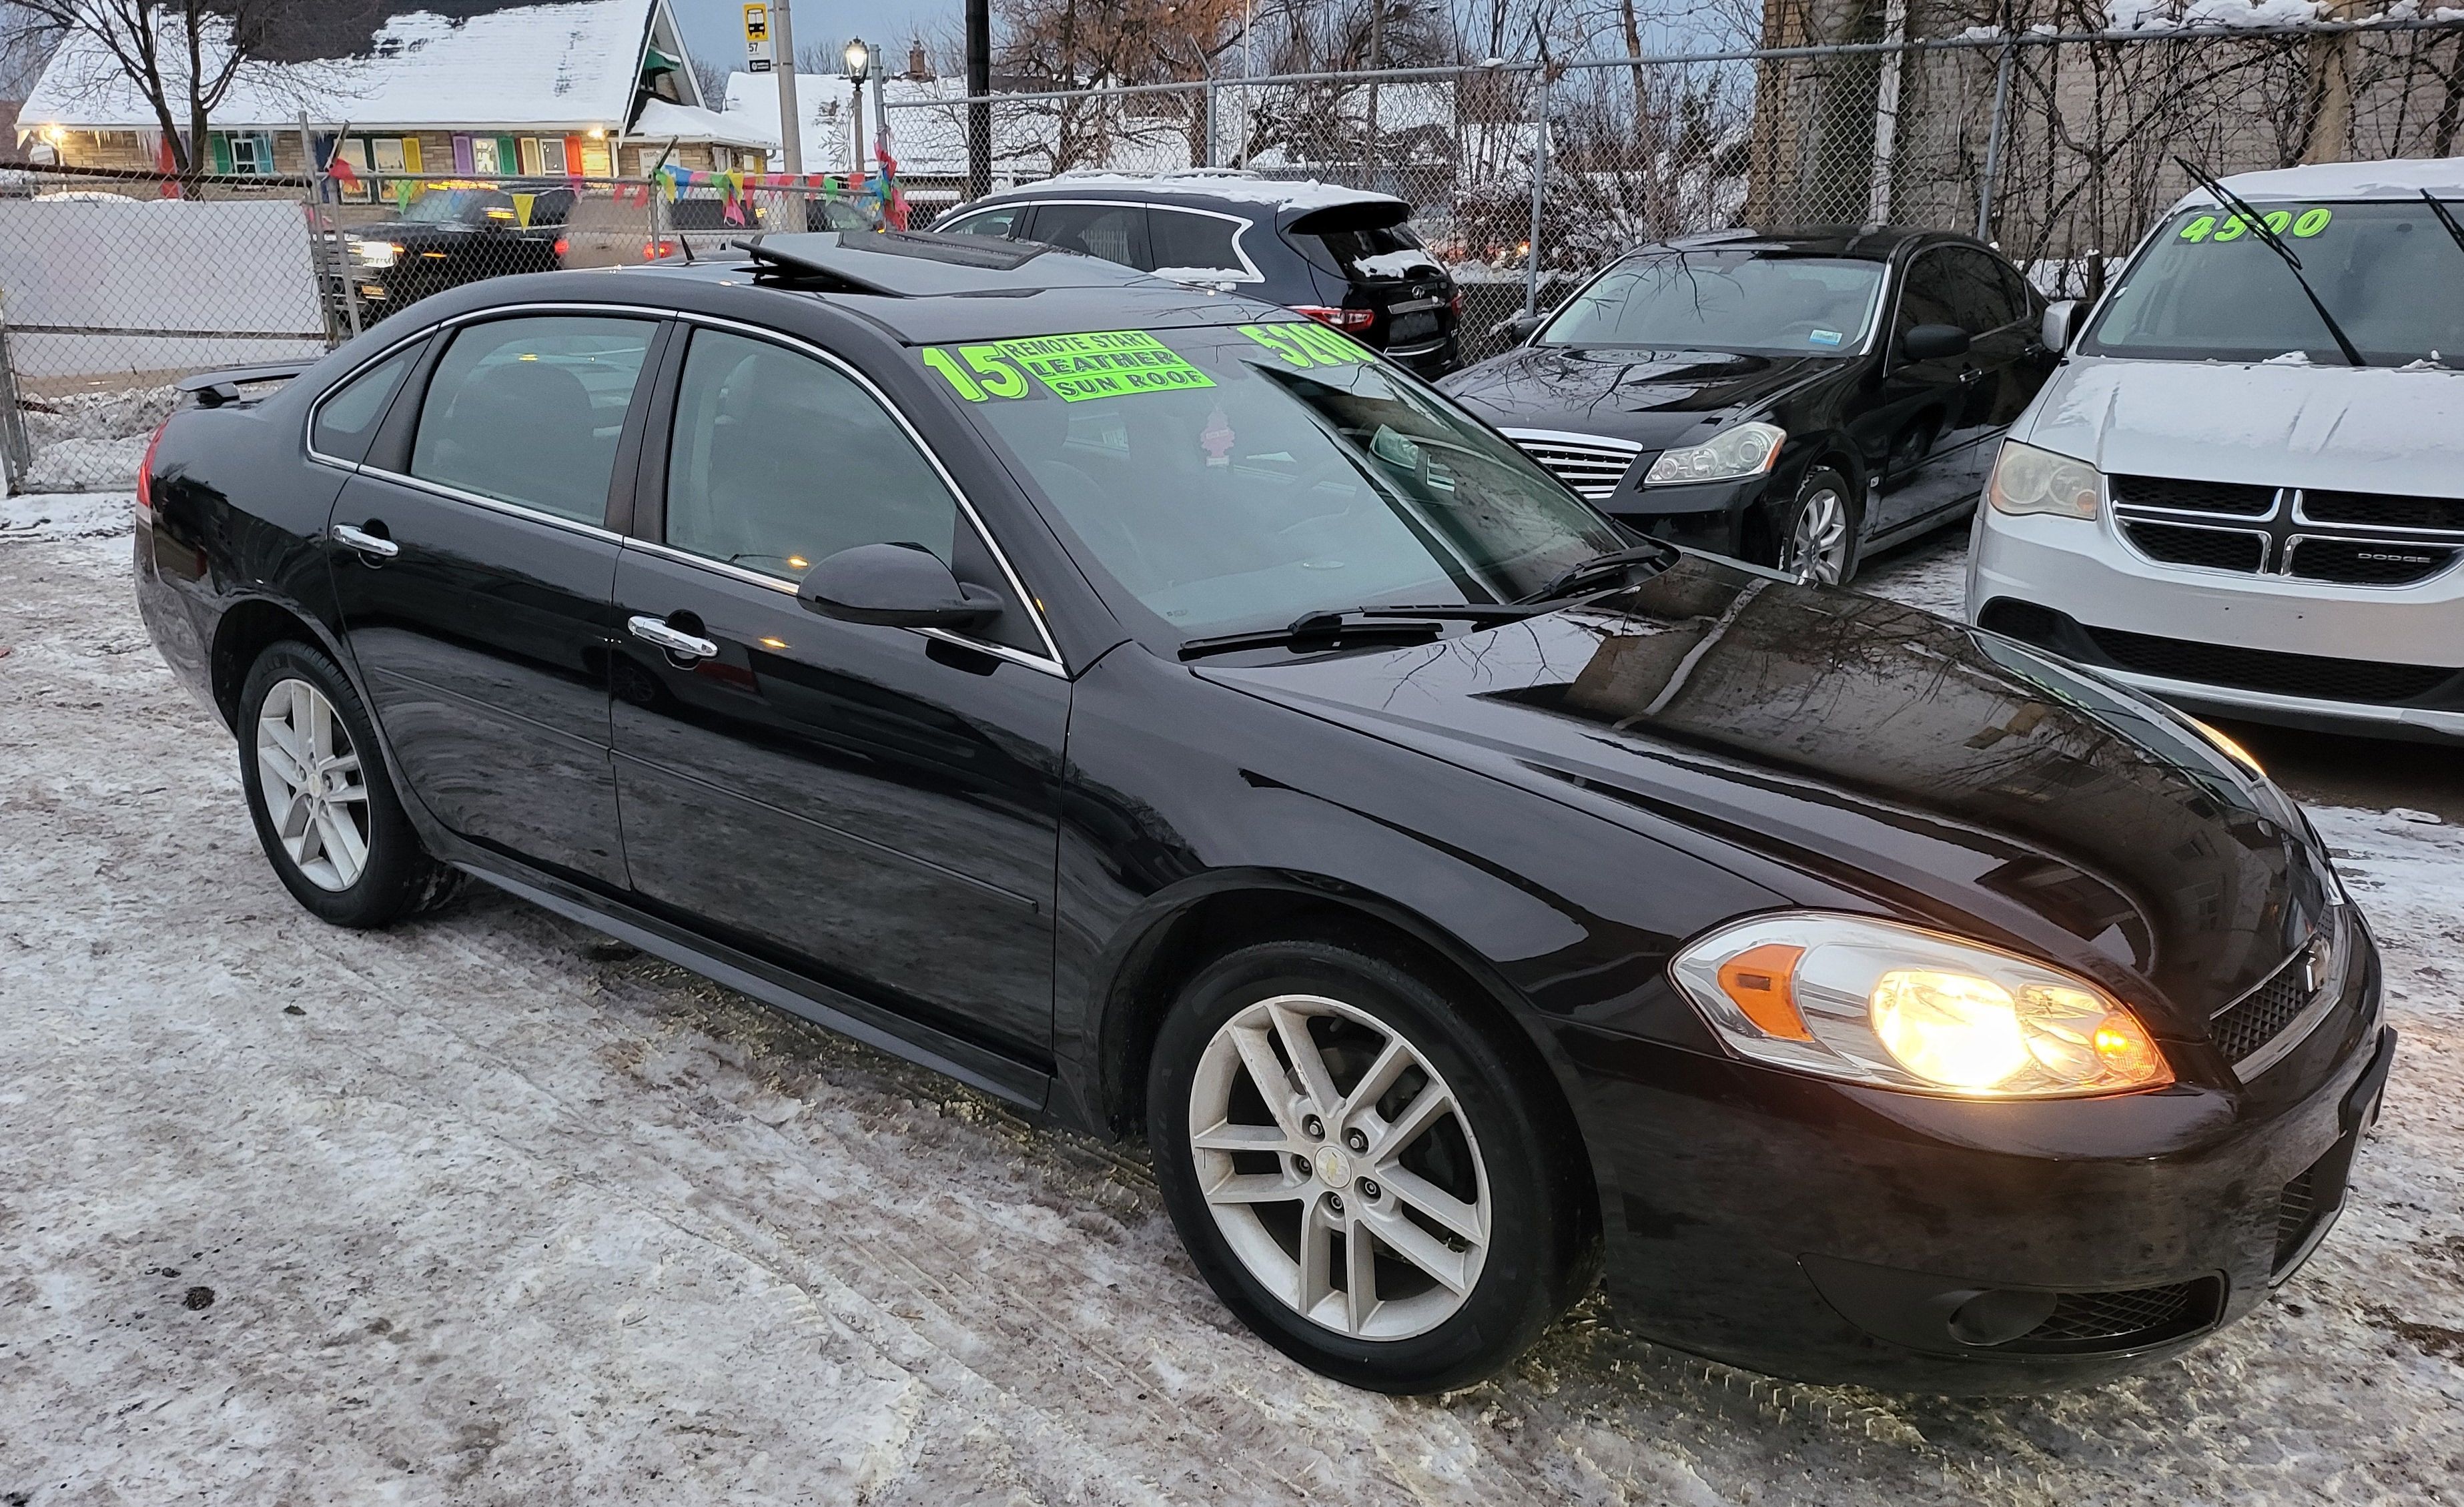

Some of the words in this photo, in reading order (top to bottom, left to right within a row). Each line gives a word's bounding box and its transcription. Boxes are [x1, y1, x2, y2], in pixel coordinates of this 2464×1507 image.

[749, 42, 759, 52] 57
[1001, 337, 1090, 358] REMOTE
[1090, 333, 1152, 348] START
[1243, 323, 1379, 369] 5200
[922, 346, 1030, 402] 15
[1028, 351, 1184, 378] LEATHER
[1056, 376, 1123, 397] SUN
[1125, 370, 1202, 388] ROOF
[2358, 553, 2431, 563] DODGE
